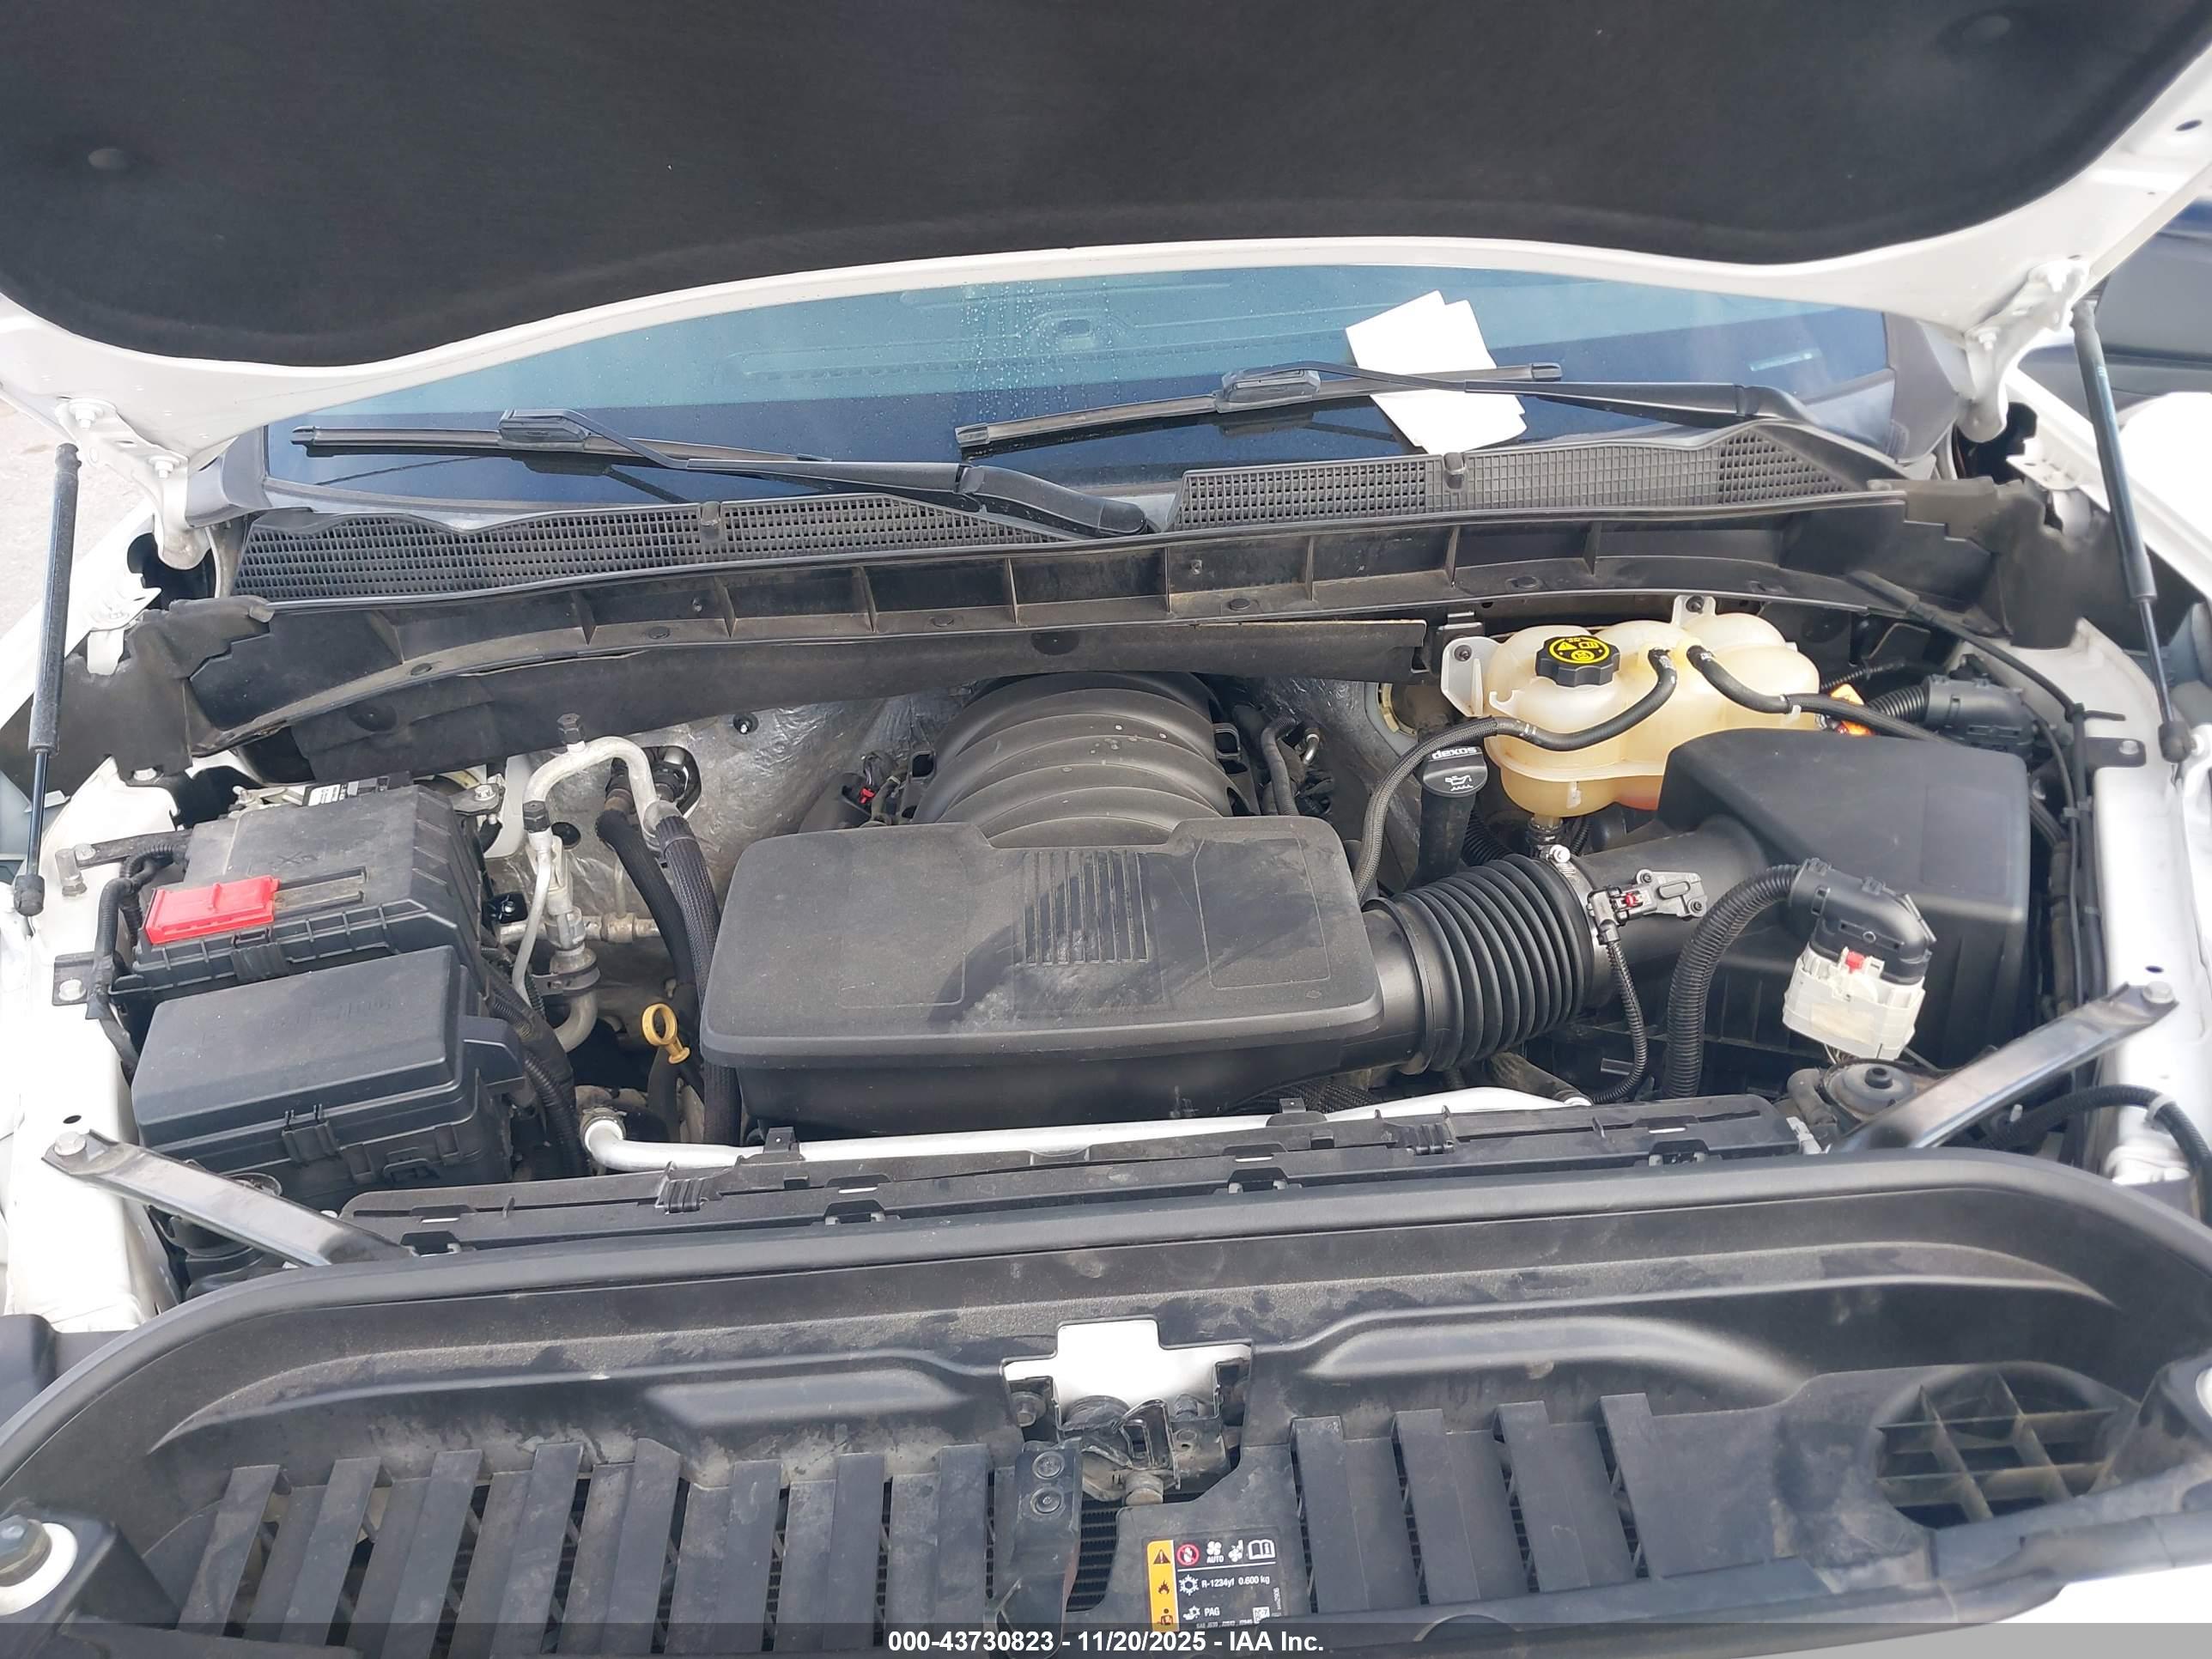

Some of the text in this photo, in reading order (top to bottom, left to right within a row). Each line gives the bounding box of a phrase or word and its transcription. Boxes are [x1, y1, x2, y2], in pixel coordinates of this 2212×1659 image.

[1431, 747, 1477, 760] dexos
[1206, 1554, 1224, 1564] AUTO
[1201, 1575, 1270, 1588] R-1234yf 0.600 kg
[1204, 1607, 1220, 1617] PAG
